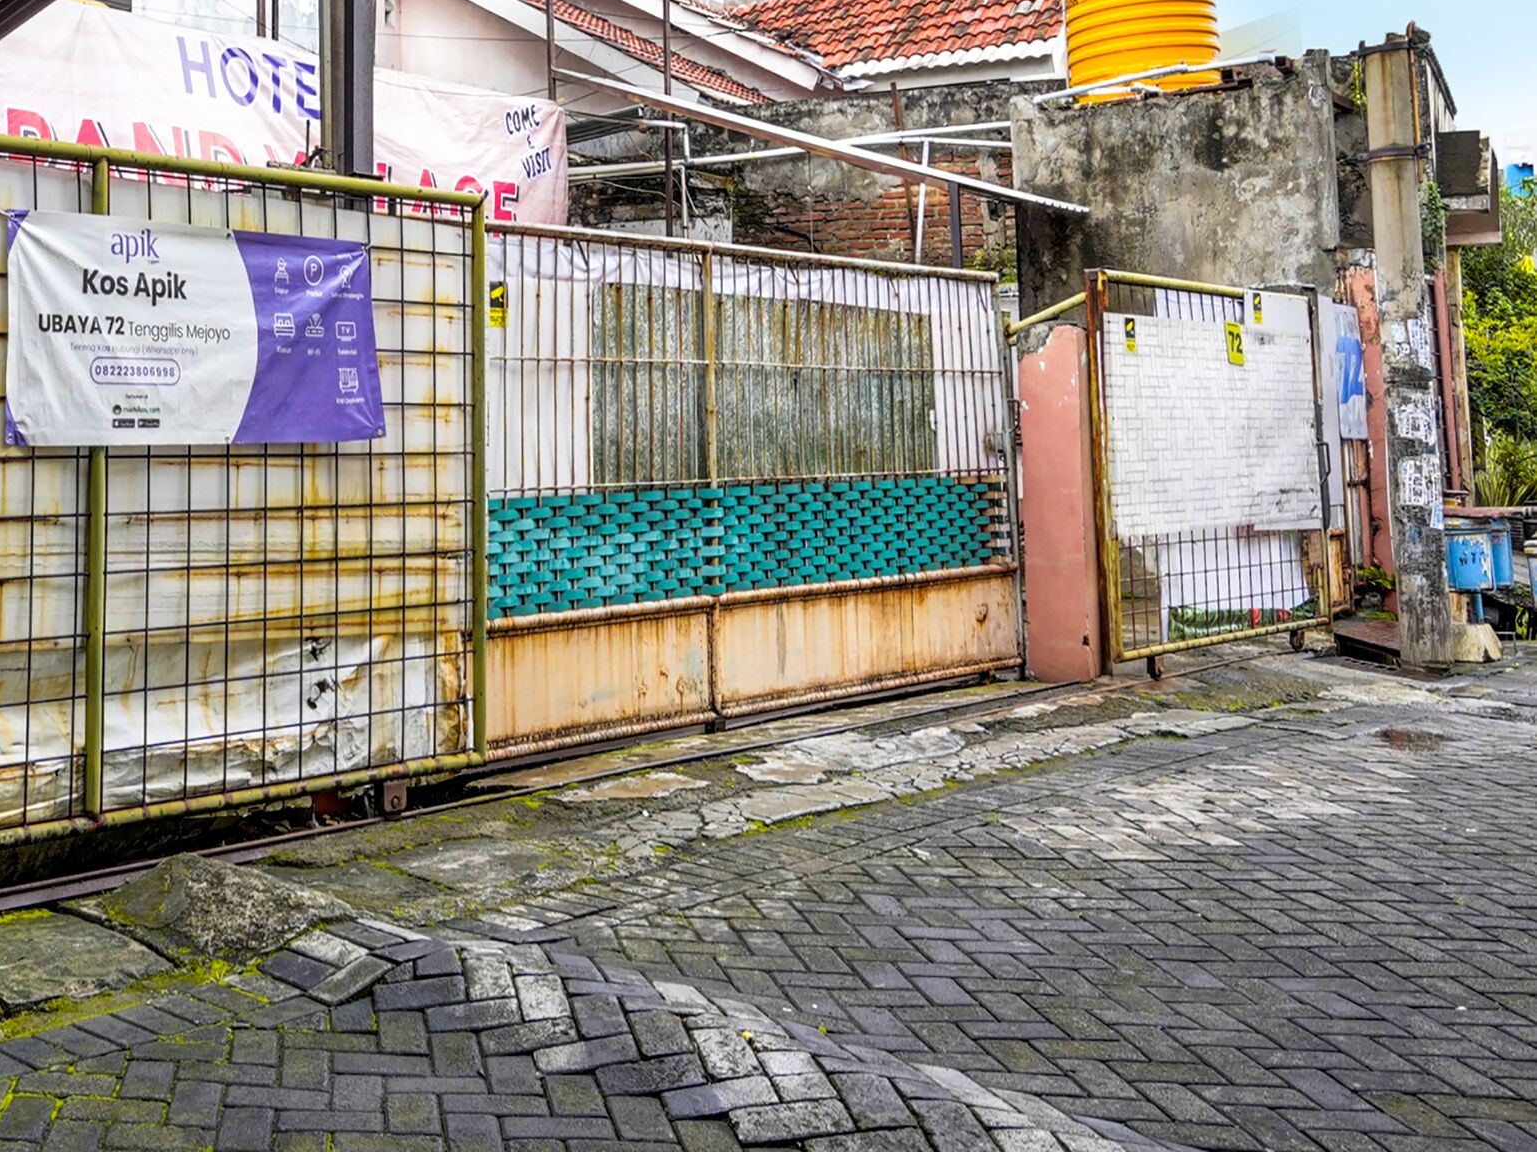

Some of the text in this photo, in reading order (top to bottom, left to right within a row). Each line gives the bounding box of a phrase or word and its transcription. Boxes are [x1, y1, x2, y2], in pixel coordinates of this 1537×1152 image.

[177, 37, 322, 120] HOTE
[505, 104, 540, 135] COME
[521, 147, 553, 179] VISIT
[110, 228, 160, 263] apik
[82, 268, 187, 307] Kos Apik
[38, 313, 231, 344] UBAYA 72 Tenggilis Mejoyo
[341, 326, 351, 334] TV
[1227, 330, 1244, 355] 72
[94, 365, 175, 378] 082223806998
[1336, 335, 1364, 404] 72
